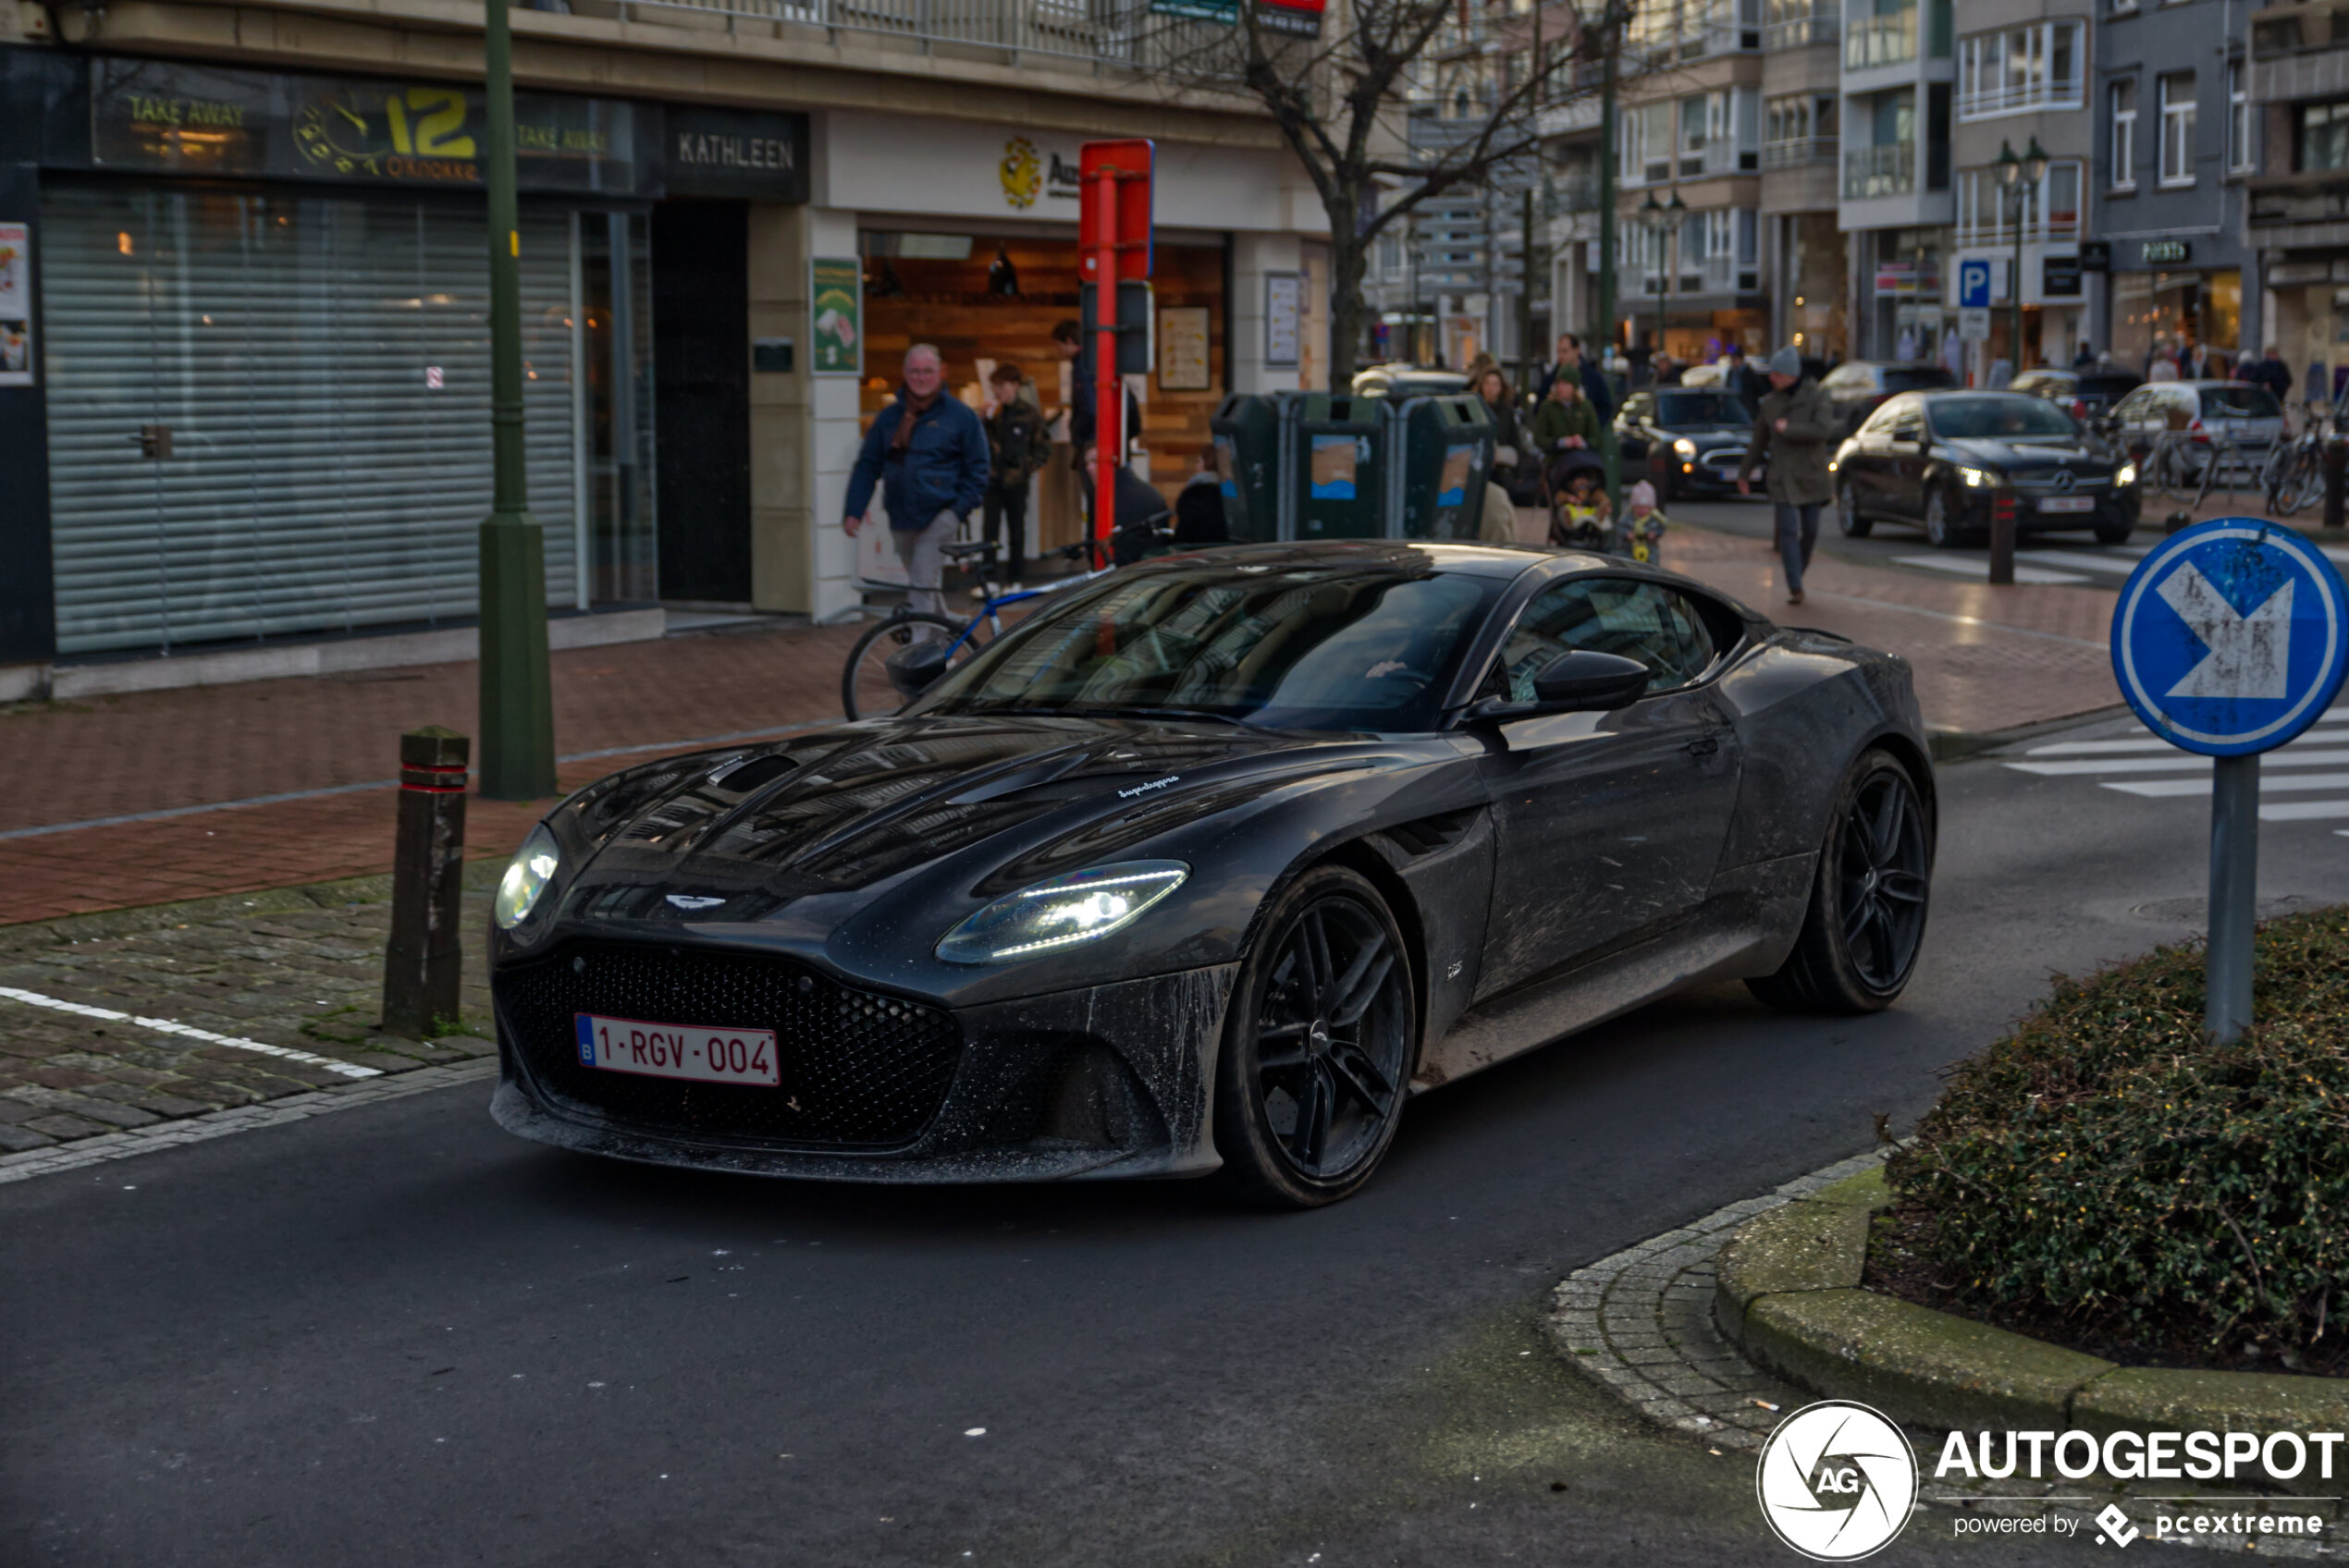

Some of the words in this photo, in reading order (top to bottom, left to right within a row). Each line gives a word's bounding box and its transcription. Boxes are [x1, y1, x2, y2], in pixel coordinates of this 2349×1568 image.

[129, 96, 181, 125] TAKE
[187, 102, 245, 128] AWAY
[387, 88, 475, 159] 12
[517, 125, 557, 150] TAKE
[561, 129, 608, 151] AWAY
[678, 132, 794, 170] KATHLEEN
[1964, 266, 1986, 301] P
[582, 1044, 593, 1060] B
[599, 1025, 769, 1075] 1-RGV-004
